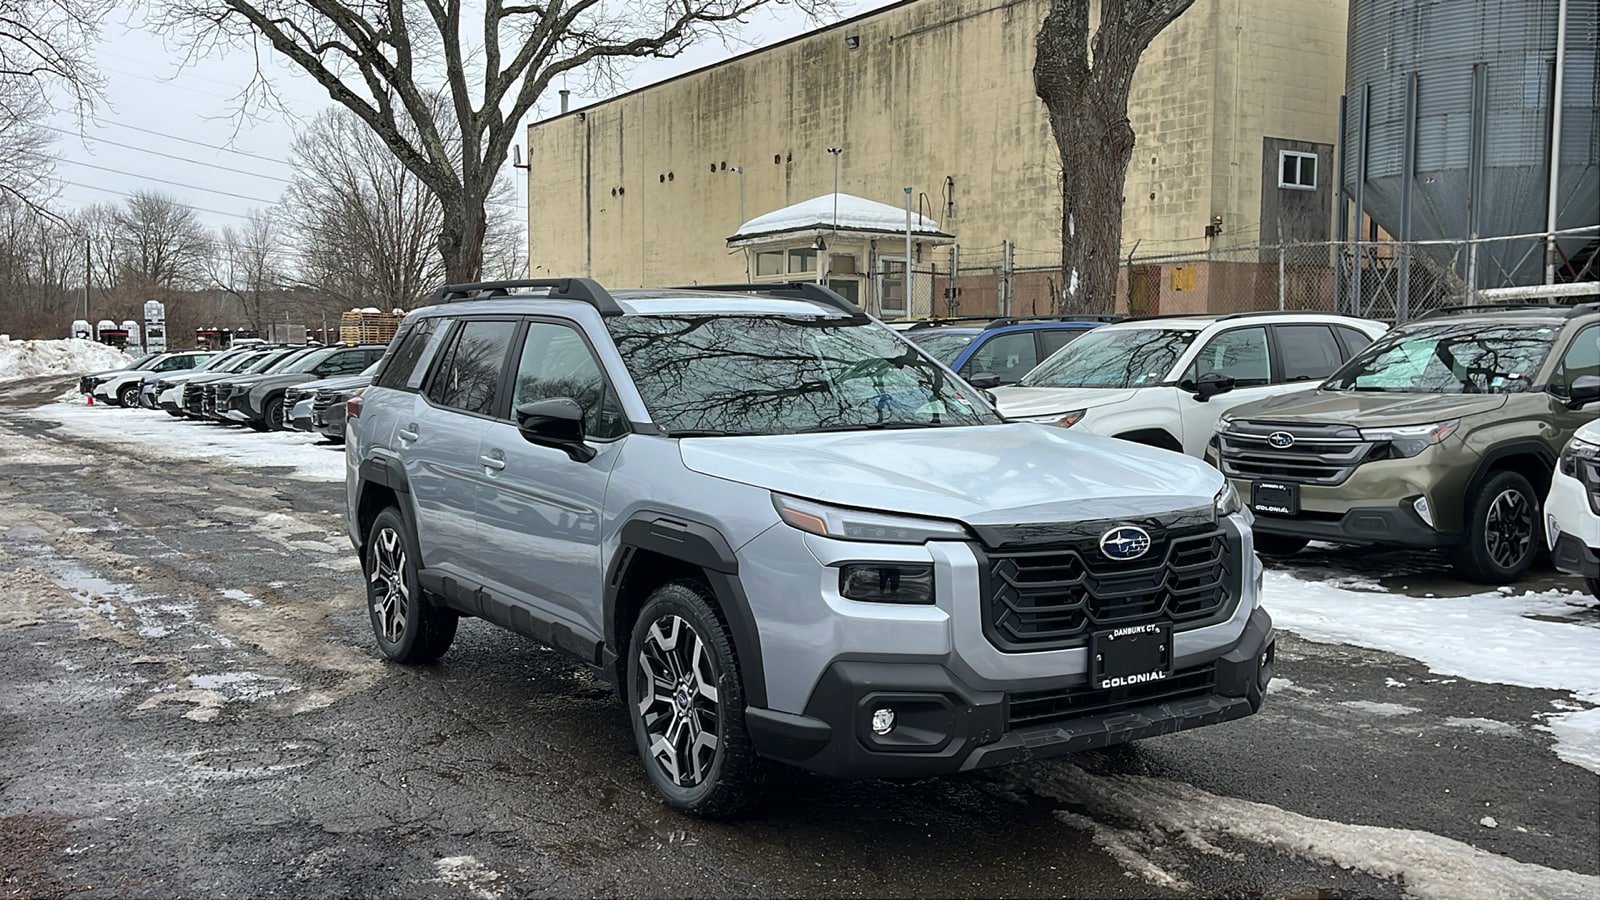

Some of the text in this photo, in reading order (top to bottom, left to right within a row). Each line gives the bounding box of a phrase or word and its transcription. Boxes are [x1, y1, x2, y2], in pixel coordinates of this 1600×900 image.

[1255, 504, 1289, 513] COLONIAL
[1113, 623, 1156, 637] DANBURY CT
[1102, 670, 1166, 689] COLONIAL
